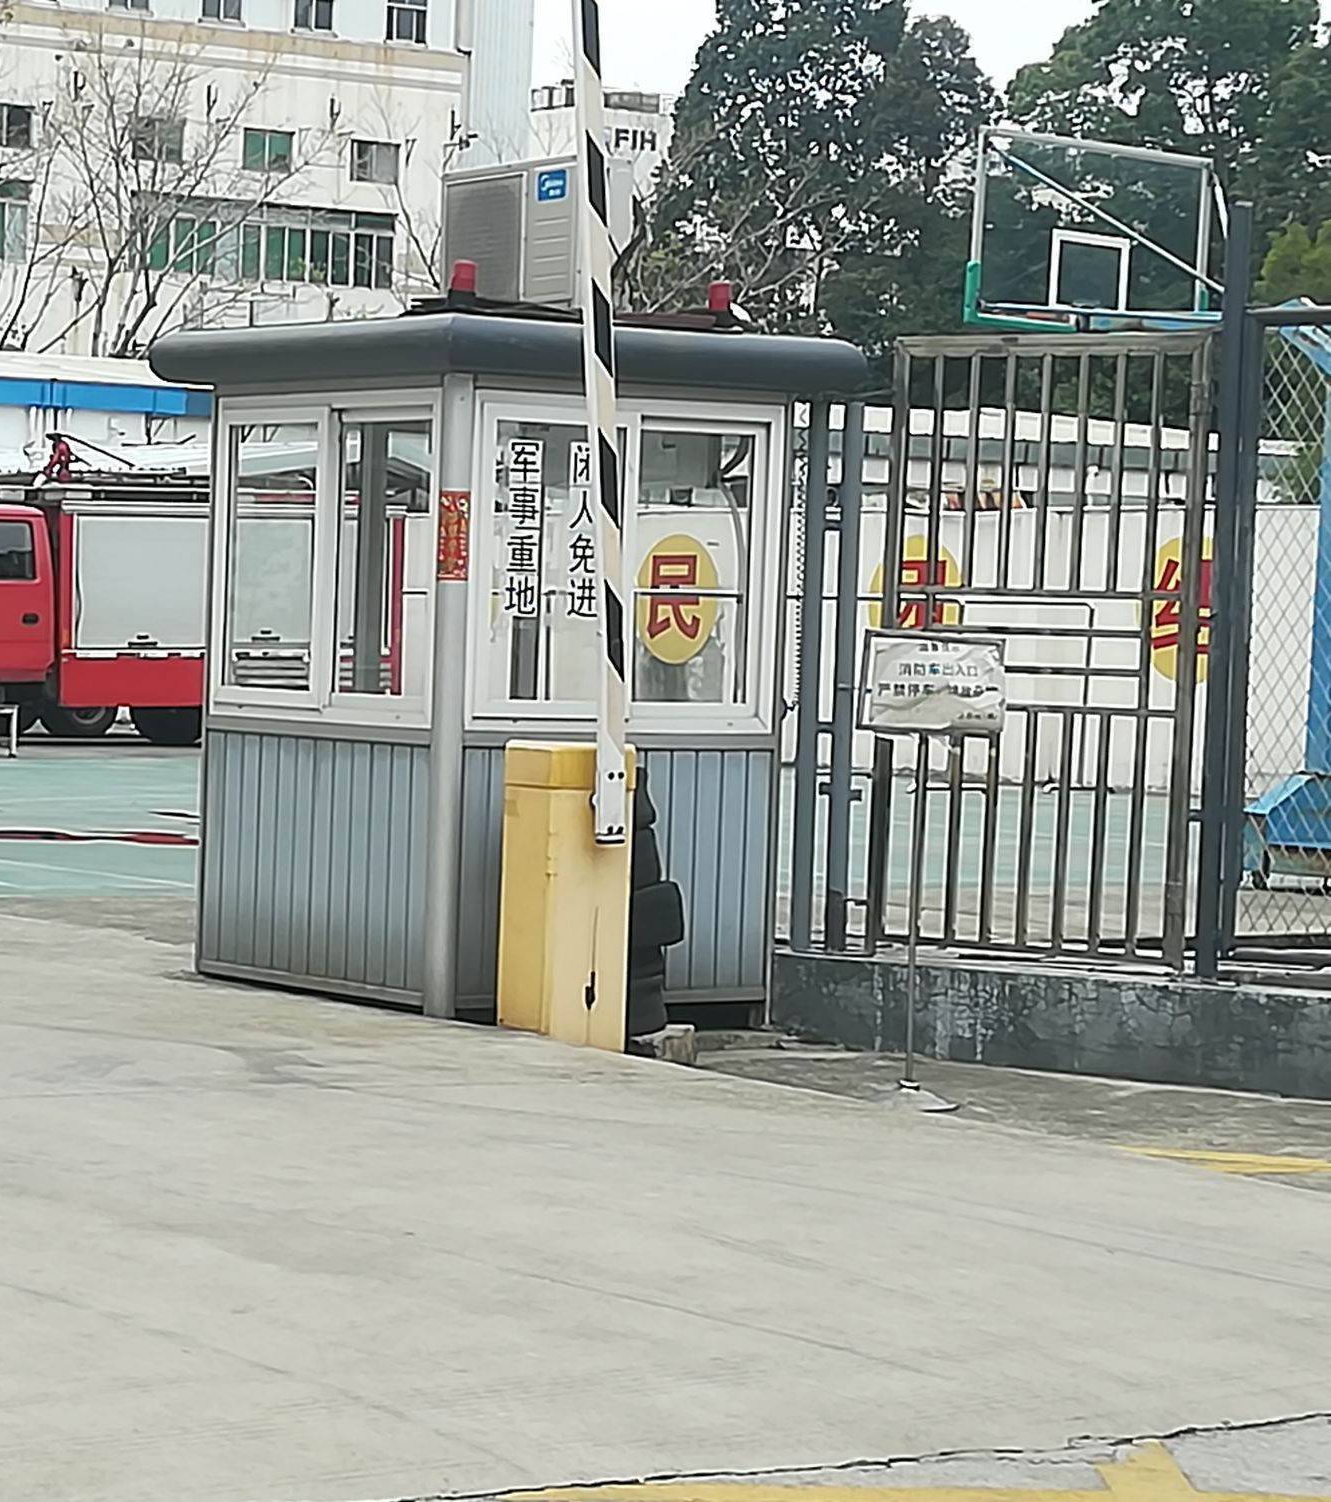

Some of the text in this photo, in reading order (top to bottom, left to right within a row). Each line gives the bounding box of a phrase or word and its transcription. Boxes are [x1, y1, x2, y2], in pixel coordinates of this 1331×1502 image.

[615, 128, 657, 152] FIH
[505, 442, 540, 616] 军事重地
[646, 554, 701, 641] 民
